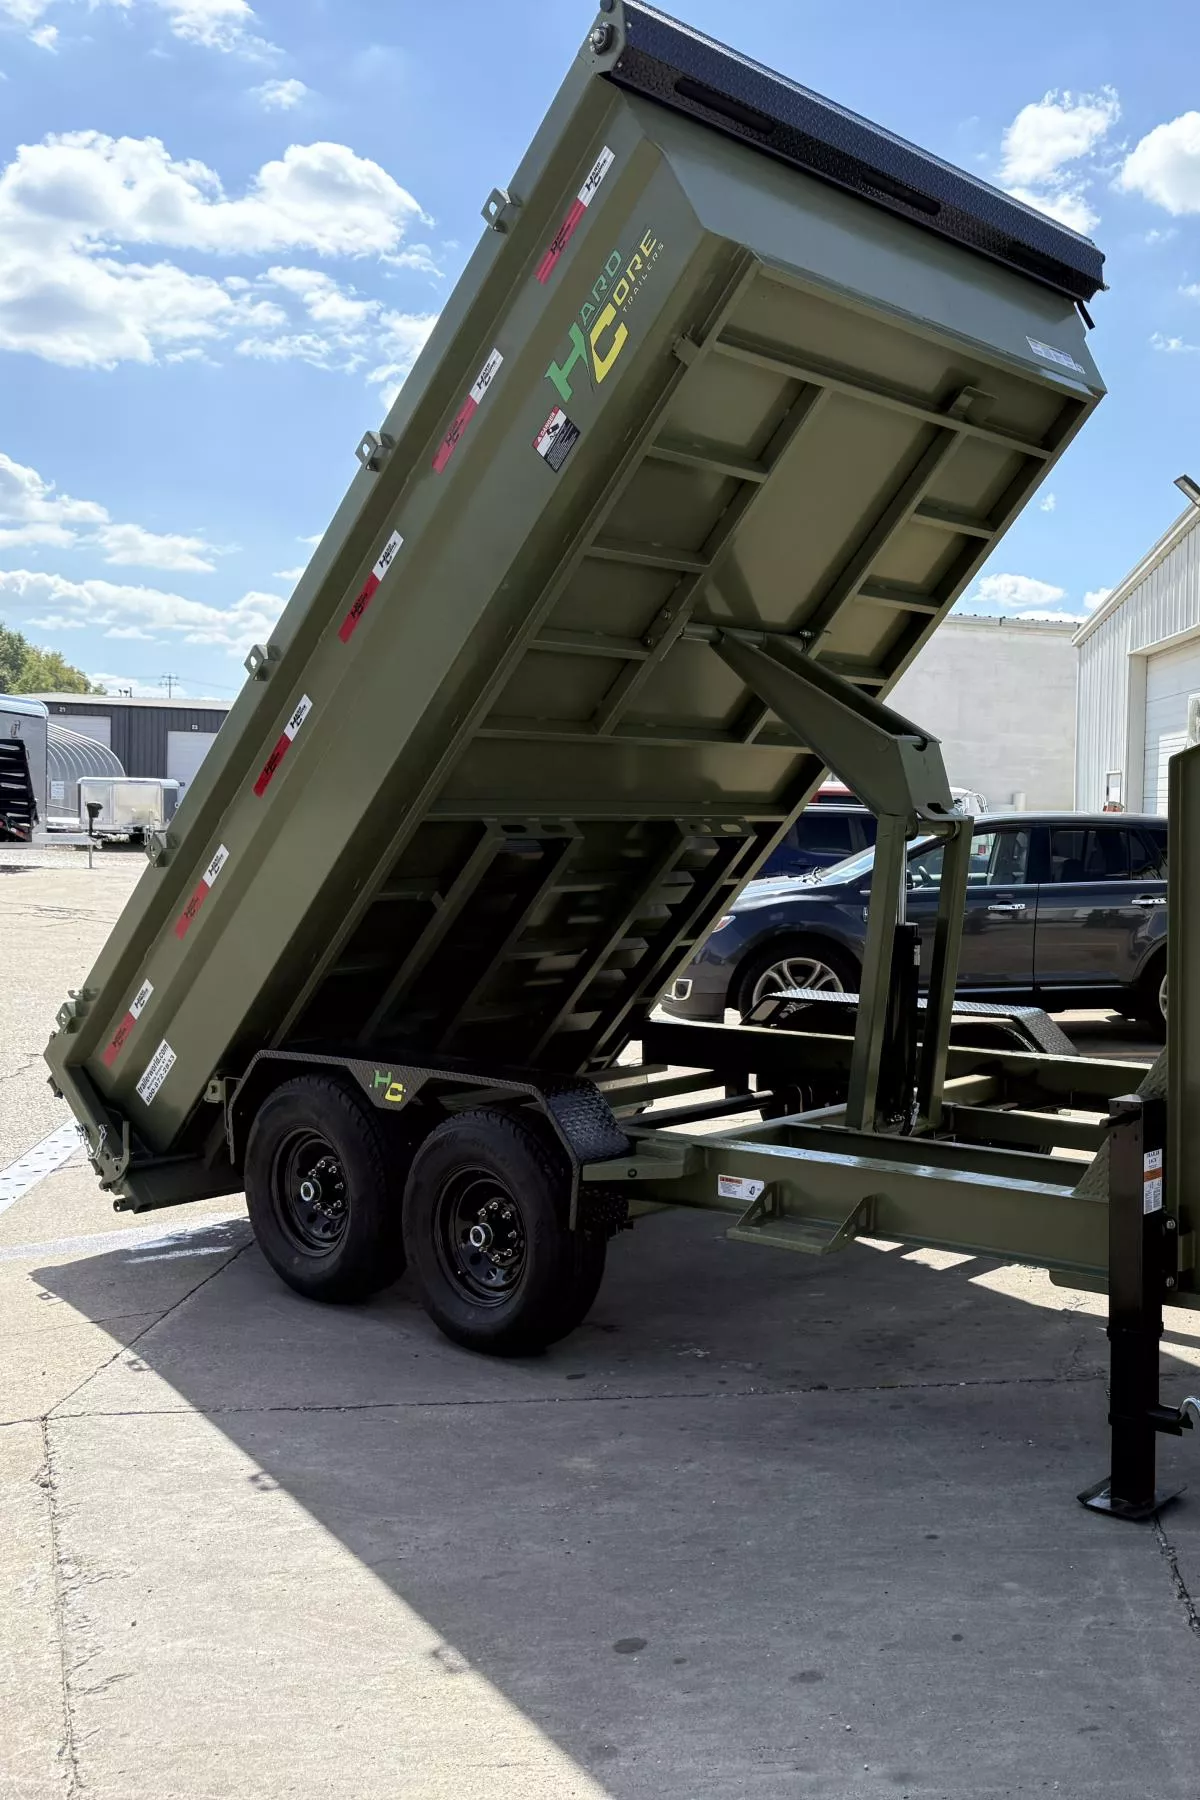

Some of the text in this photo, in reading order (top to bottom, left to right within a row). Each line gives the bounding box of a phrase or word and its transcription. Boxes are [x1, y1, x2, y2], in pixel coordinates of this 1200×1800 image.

[590, 229, 657, 384] CORE
[622, 242, 664, 313] TRAILERS
[544, 249, 622, 402] HARD
[137, 1043, 169, 1095] trailerworld.com
[145, 1054, 176, 1103] 800-872-2833
